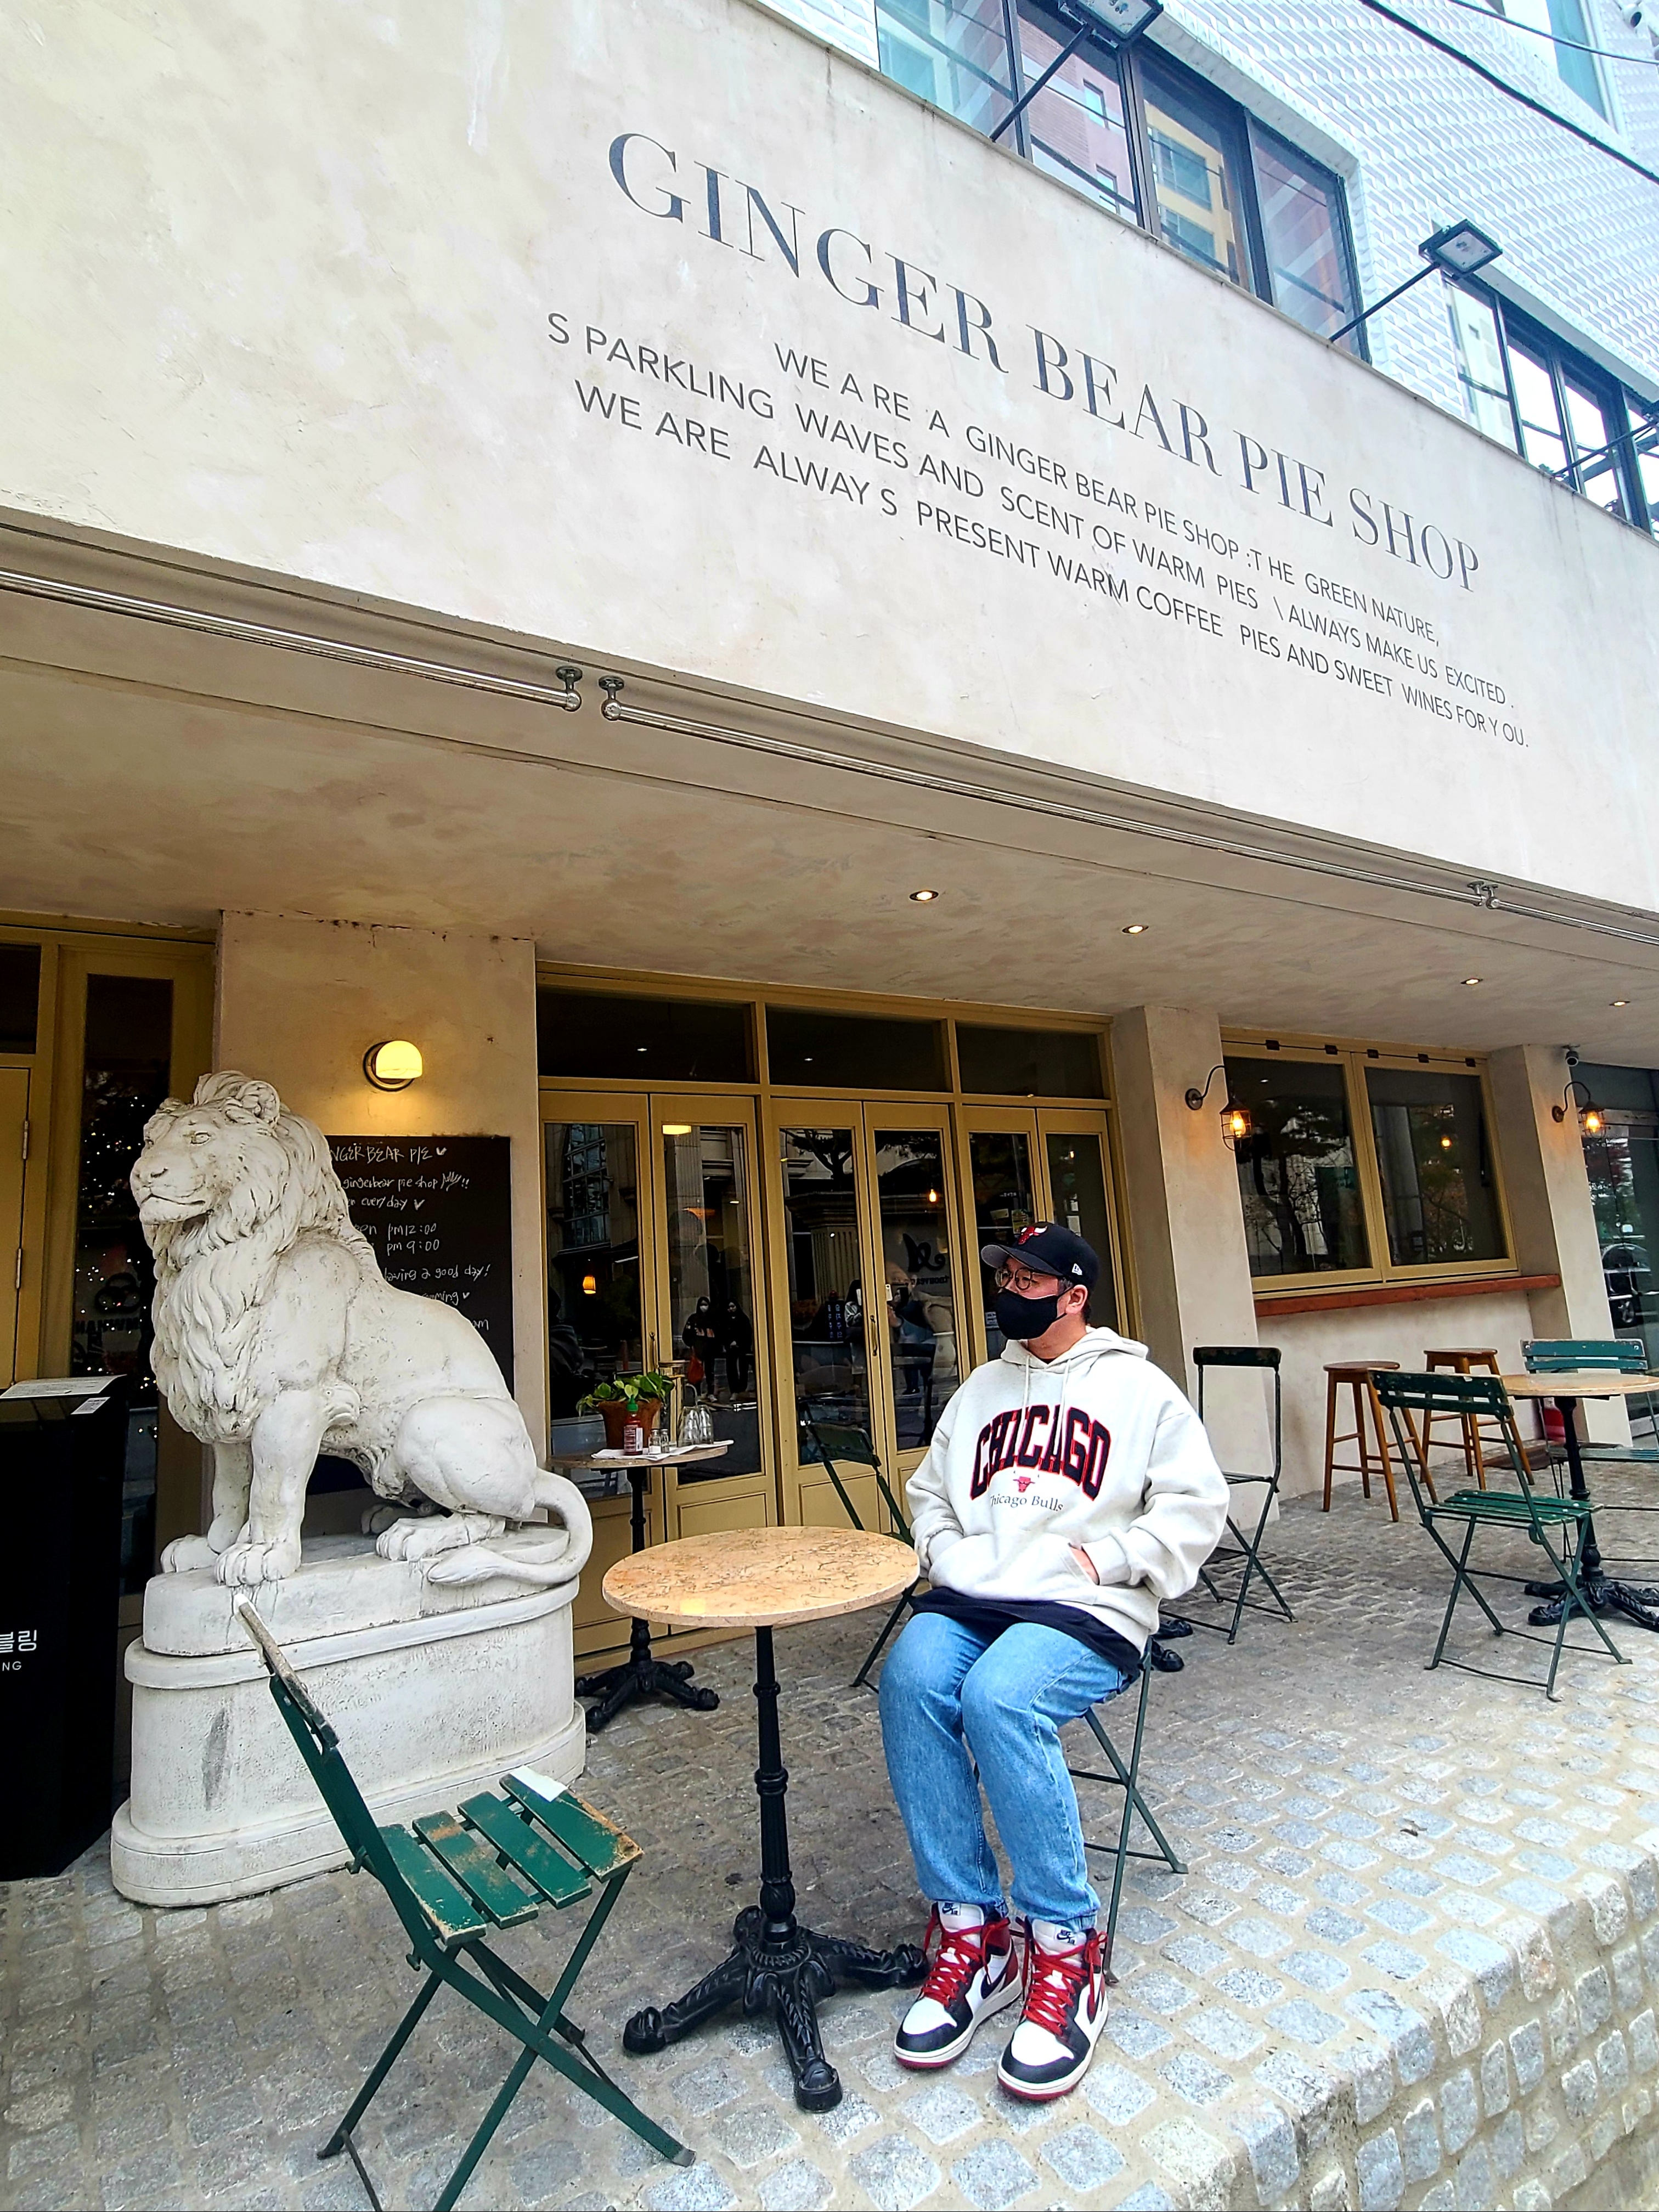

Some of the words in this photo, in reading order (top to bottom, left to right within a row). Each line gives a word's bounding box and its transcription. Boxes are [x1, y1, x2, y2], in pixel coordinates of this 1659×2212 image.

[608, 133, 1009, 374] GINGER
[1025, 324, 1222, 477] BEAR
[1233, 430, 1333, 528] PIE
[1350, 488, 1479, 592] SHOP
[774, 342, 830, 389] WE
[928, 409, 950, 438] A
[966, 425, 1068, 490] GINGER
[1075, 472, 1138, 518] BEAR
[1144, 501, 1178, 535] PIE
[1183, 520, 1239, 560] SHOP
[1305, 573, 1367, 613] GREEN
[1372, 598, 1439, 647] NATURE,
[574, 379, 642, 430] WE
[655, 411, 731, 460] ARE
[917, 500, 1040, 568] PRESENT
[1047, 550, 1128, 604] WARM
[1136, 585, 1223, 637] COFFEE
[1240, 624, 1280, 658] PIES
[1287, 644, 1329, 674] AND
[1334, 659, 1393, 697] SWEET
[1401, 683, 1453, 720] WINES
[1455, 705, 1487, 733] FOR
[795, 403, 909, 469] WAVES
[918, 454, 984, 497] AND
[1000, 486, 1084, 539] SCENT
[1092, 525, 1126, 554] OF
[1132, 539, 1205, 589] WARM
[1217, 574, 1258, 610] PIES
[1289, 604, 1361, 648] ALWAYS
[1365, 632, 1415, 669] MAKE
[1417, 653, 1438, 679] US
[330, 1146, 365, 1161] NGER
[366, 1146, 405, 1164] BEAR
[410, 1146, 433, 1165] PIE
[398, 1179, 413, 1192] pie
[415, 1175, 438, 1190] shop
[387, 1243, 402, 1256] pm
[406, 1239, 439, 1254] 9:00
[421, 1268, 431, 1279] a
[435, 1264, 459, 1279] good
[970, 1404, 1111, 1501] CHICAGO
[990, 1493, 1028, 1509] hicago
[1031, 1496, 1064, 1512] Bulls
